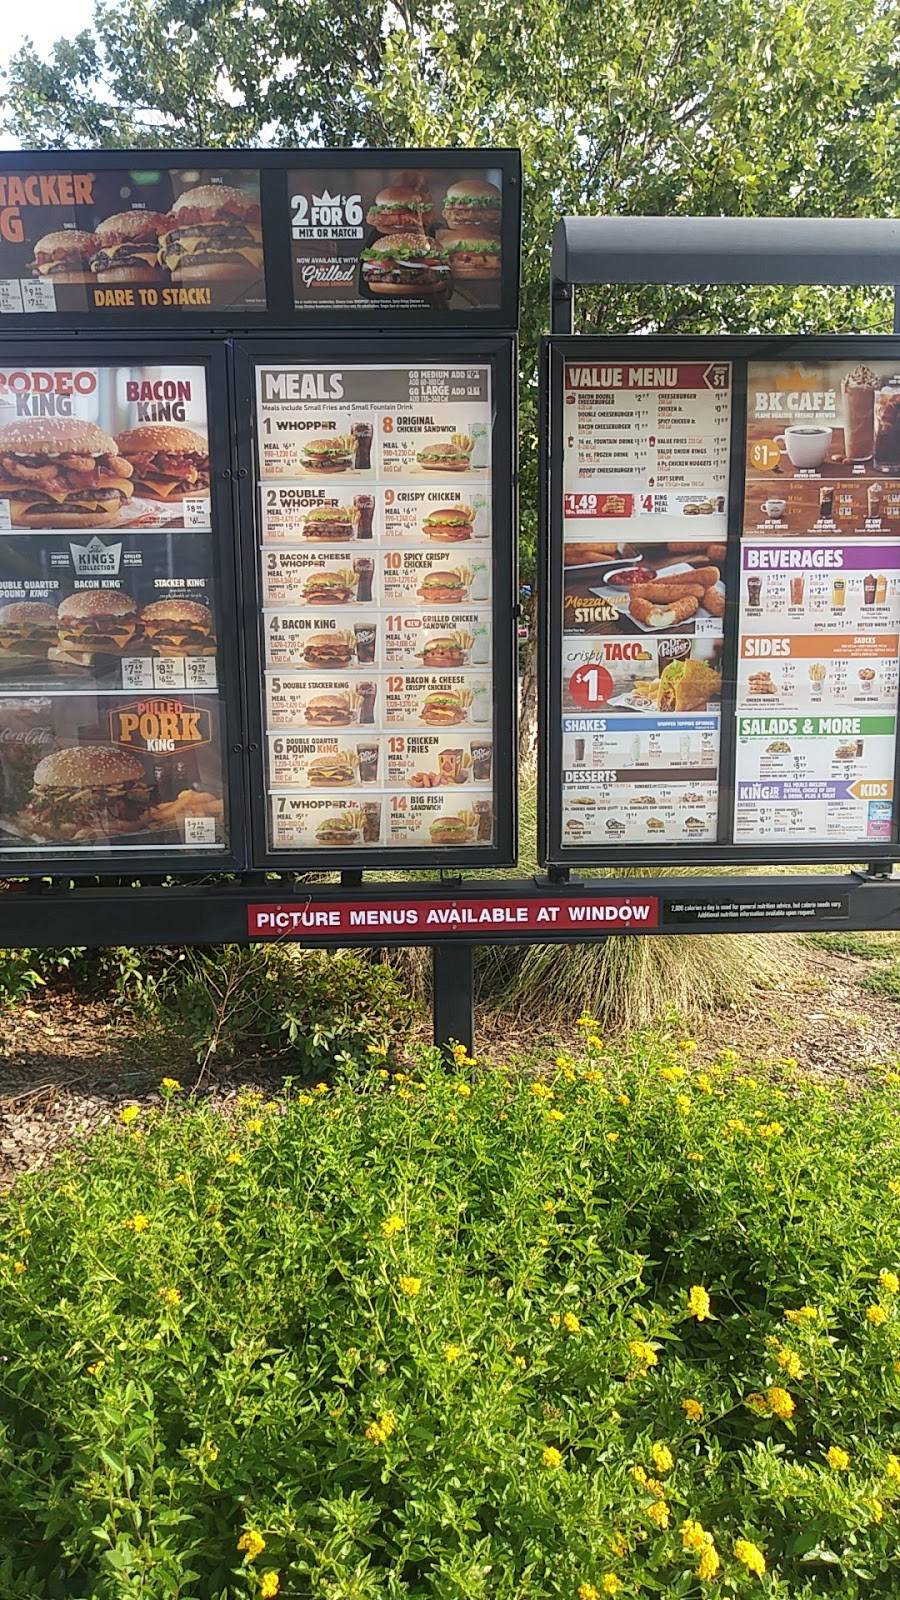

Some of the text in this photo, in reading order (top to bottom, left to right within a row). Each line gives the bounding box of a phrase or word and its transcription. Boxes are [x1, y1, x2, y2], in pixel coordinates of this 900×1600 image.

[291, 195, 308, 226] 2
[311, 207, 344, 225] FOR
[299, 228, 357, 237] MIX OR MATCH
[302, 265, 355, 288] Grilled
[94, 287, 212, 307] DARE TO STACK!
[569, 368, 678, 387] VALUE MENU
[714, 375, 725, 387] $1
[126, 381, 192, 402] BACON
[265, 373, 345, 400] MEALS
[421, 386, 449, 395] LARGE
[16, 394, 72, 417] KING
[755, 388, 836, 411] BK CAFÉ
[138, 402, 187, 422] KING
[263, 417, 337, 435] 1 WHOPPER
[383, 416, 434, 433] 8 ORIGINAL
[424, 425, 456, 433] SANDWICH
[267, 490, 325, 507] 2 DOUBLE
[280, 499, 338, 507] WHOPPER
[385, 489, 461, 506] 9 CRISPY CHICKEN
[640, 495, 653, 512] $4
[78, 553, 115, 565] KING'S
[268, 553, 277, 569] 3
[384, 552, 402, 569] 10
[748, 549, 844, 568] BEVERAGES
[24, 581, 59, 589] QUARTER
[74, 580, 121, 589] BACON KING
[154, 579, 205, 588] STACKER KING
[30, 589, 49, 598] KING
[575, 607, 619, 623] STICKS
[270, 616, 336, 632] 4 BACON KING
[386, 616, 402, 631] 11
[567, 643, 642, 666] crispy TACO
[659, 642, 690, 658] Pepper
[745, 638, 791, 657] SIDES
[272, 678, 281, 693] 5
[386, 676, 404, 692] 12
[405, 676, 429, 684] BACON
[137, 703, 183, 715] PULLED
[120, 713, 202, 741] PORK
[565, 720, 607, 731] SHAKES
[742, 718, 861, 735] SALADS & MORE
[147, 739, 175, 751] KING
[273, 738, 284, 753] 6
[286, 745, 338, 753] POUND KING
[388, 736, 439, 753] 13 CHICKEN
[565, 771, 617, 783] DESSERTS
[741, 786, 770, 799] KING
[860, 784, 888, 797] KIDS
[277, 797, 286, 812] 7
[290, 801, 346, 809] WHOPPER
[390, 796, 444, 811] 14 BIG FISH
[257, 906, 650, 928] PICTURE MENUS AVAILABLE AT WINDOW
